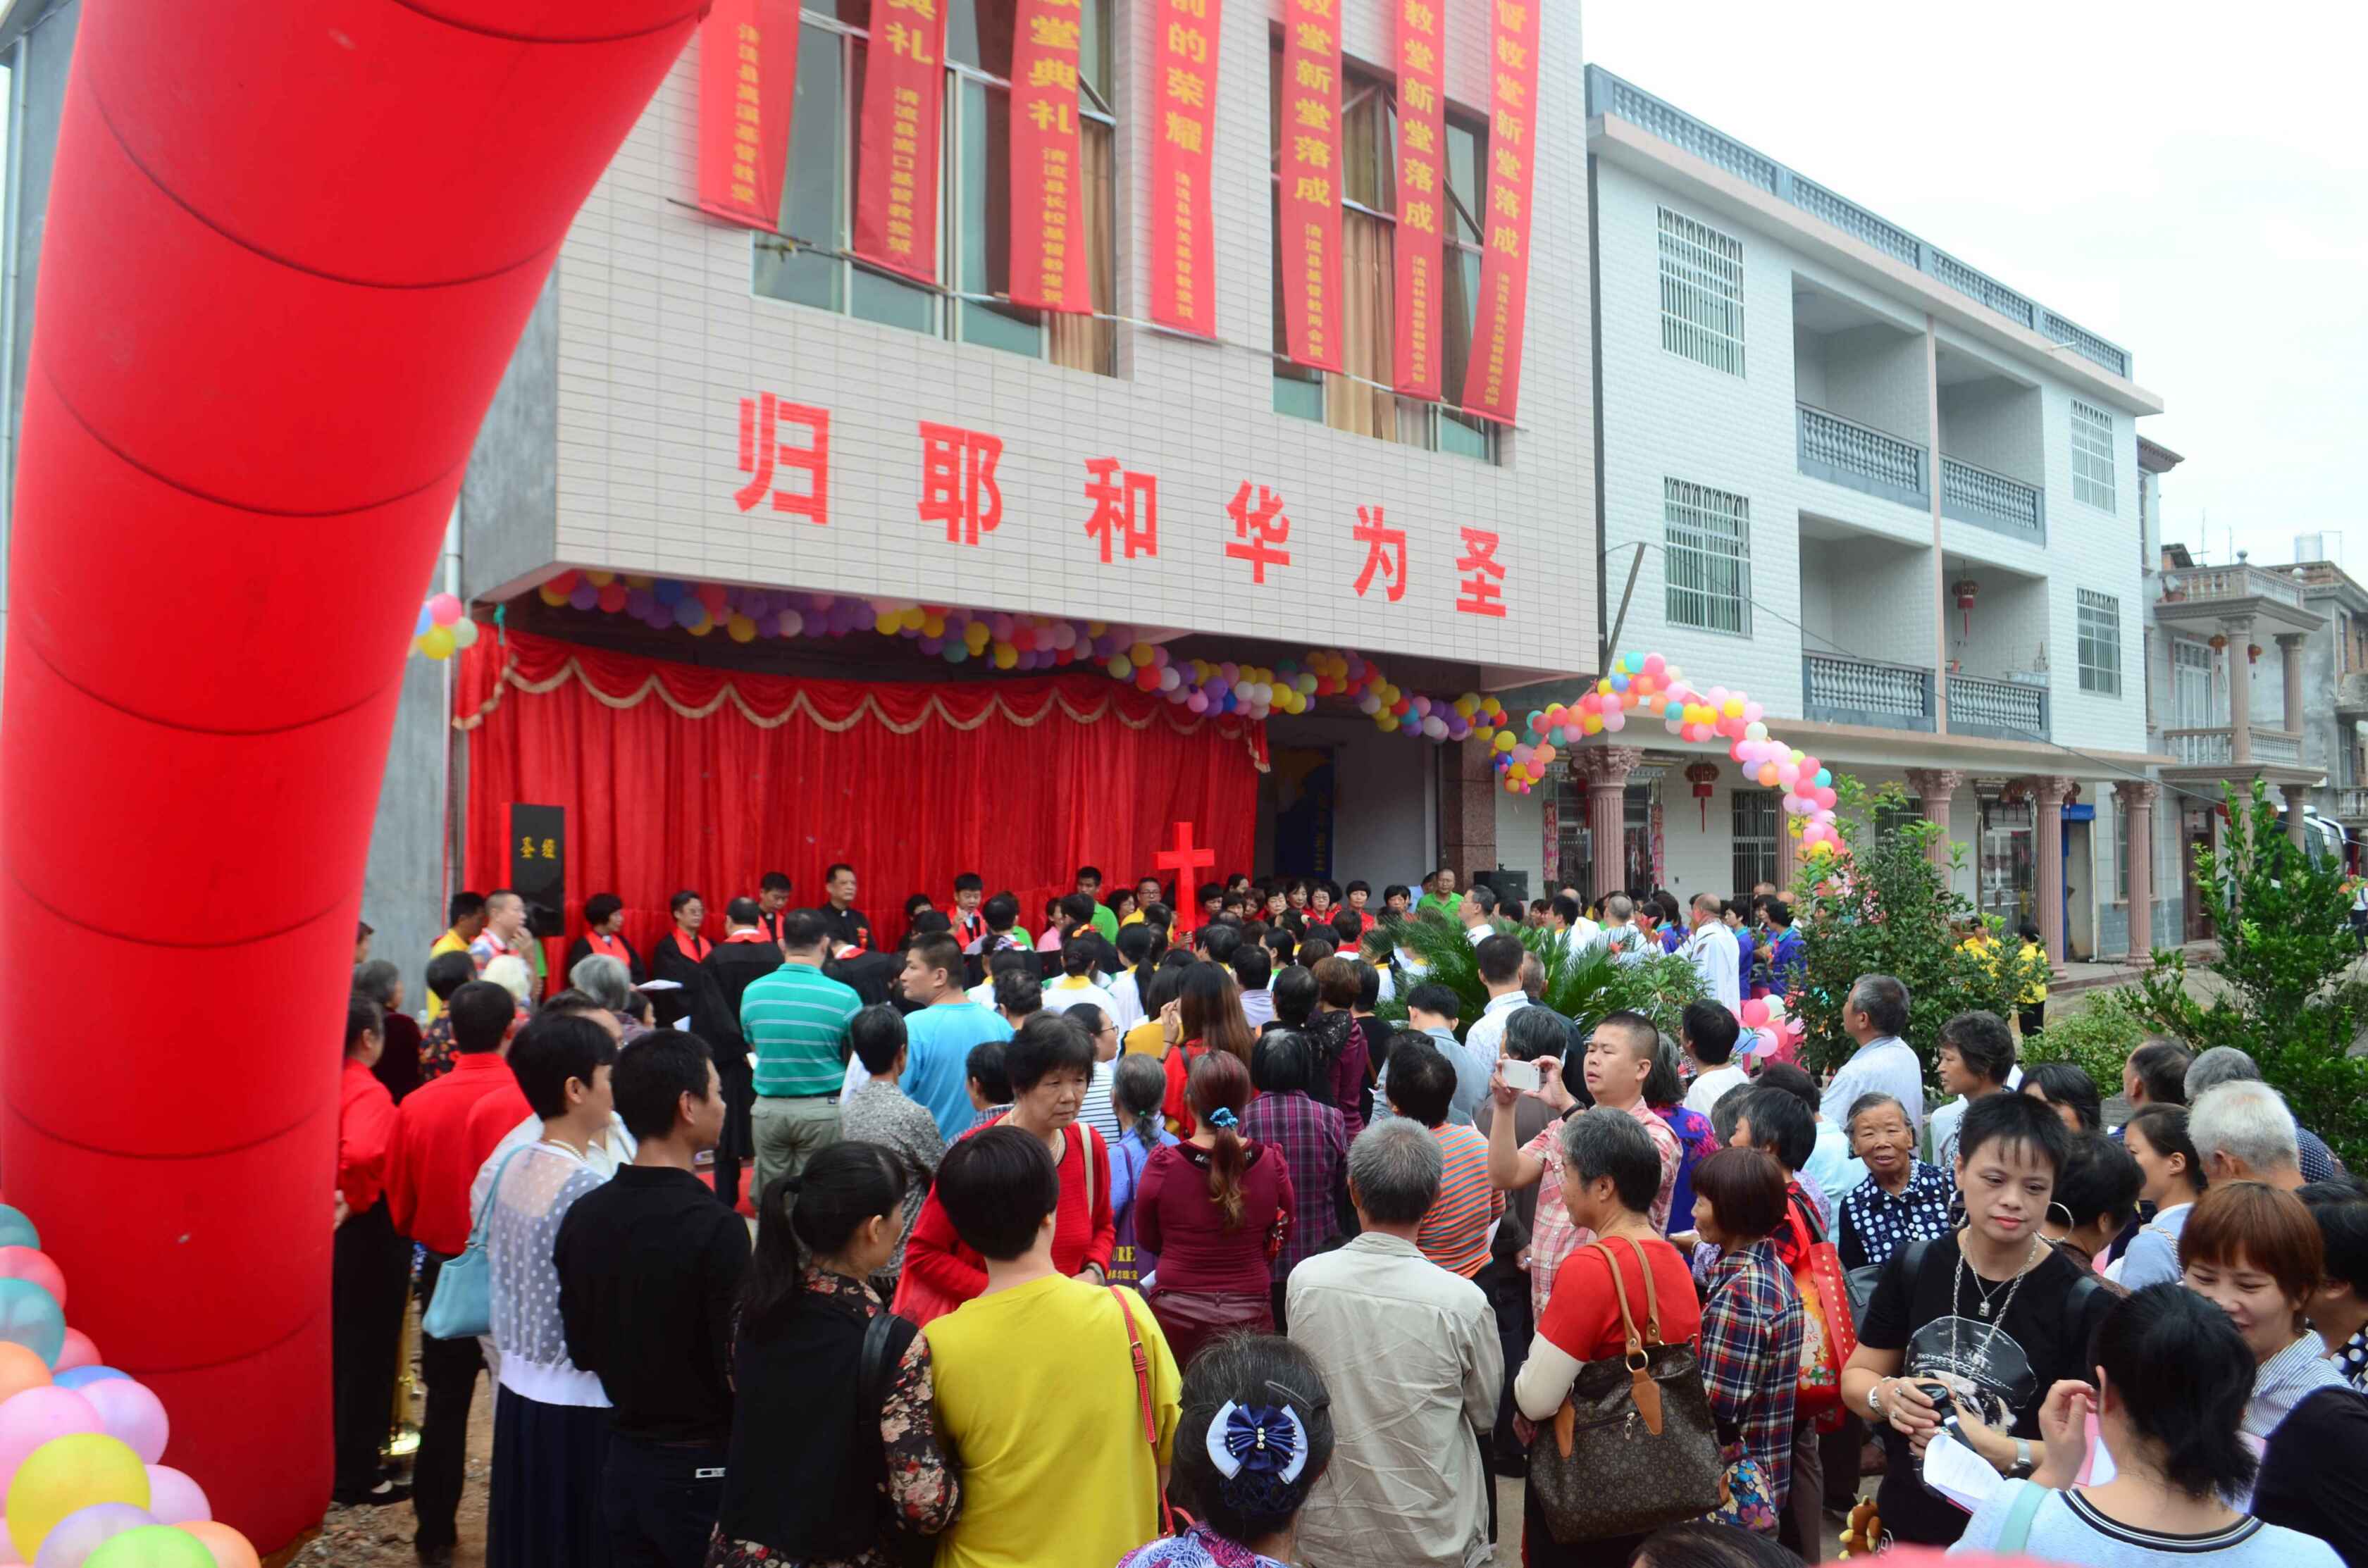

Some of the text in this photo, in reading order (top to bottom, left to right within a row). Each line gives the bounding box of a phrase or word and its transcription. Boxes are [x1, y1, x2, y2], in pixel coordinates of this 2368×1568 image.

[1028, 0, 1080, 135] 堂典礼
[733, 392, 1506, 618] 归耶和华为圣
